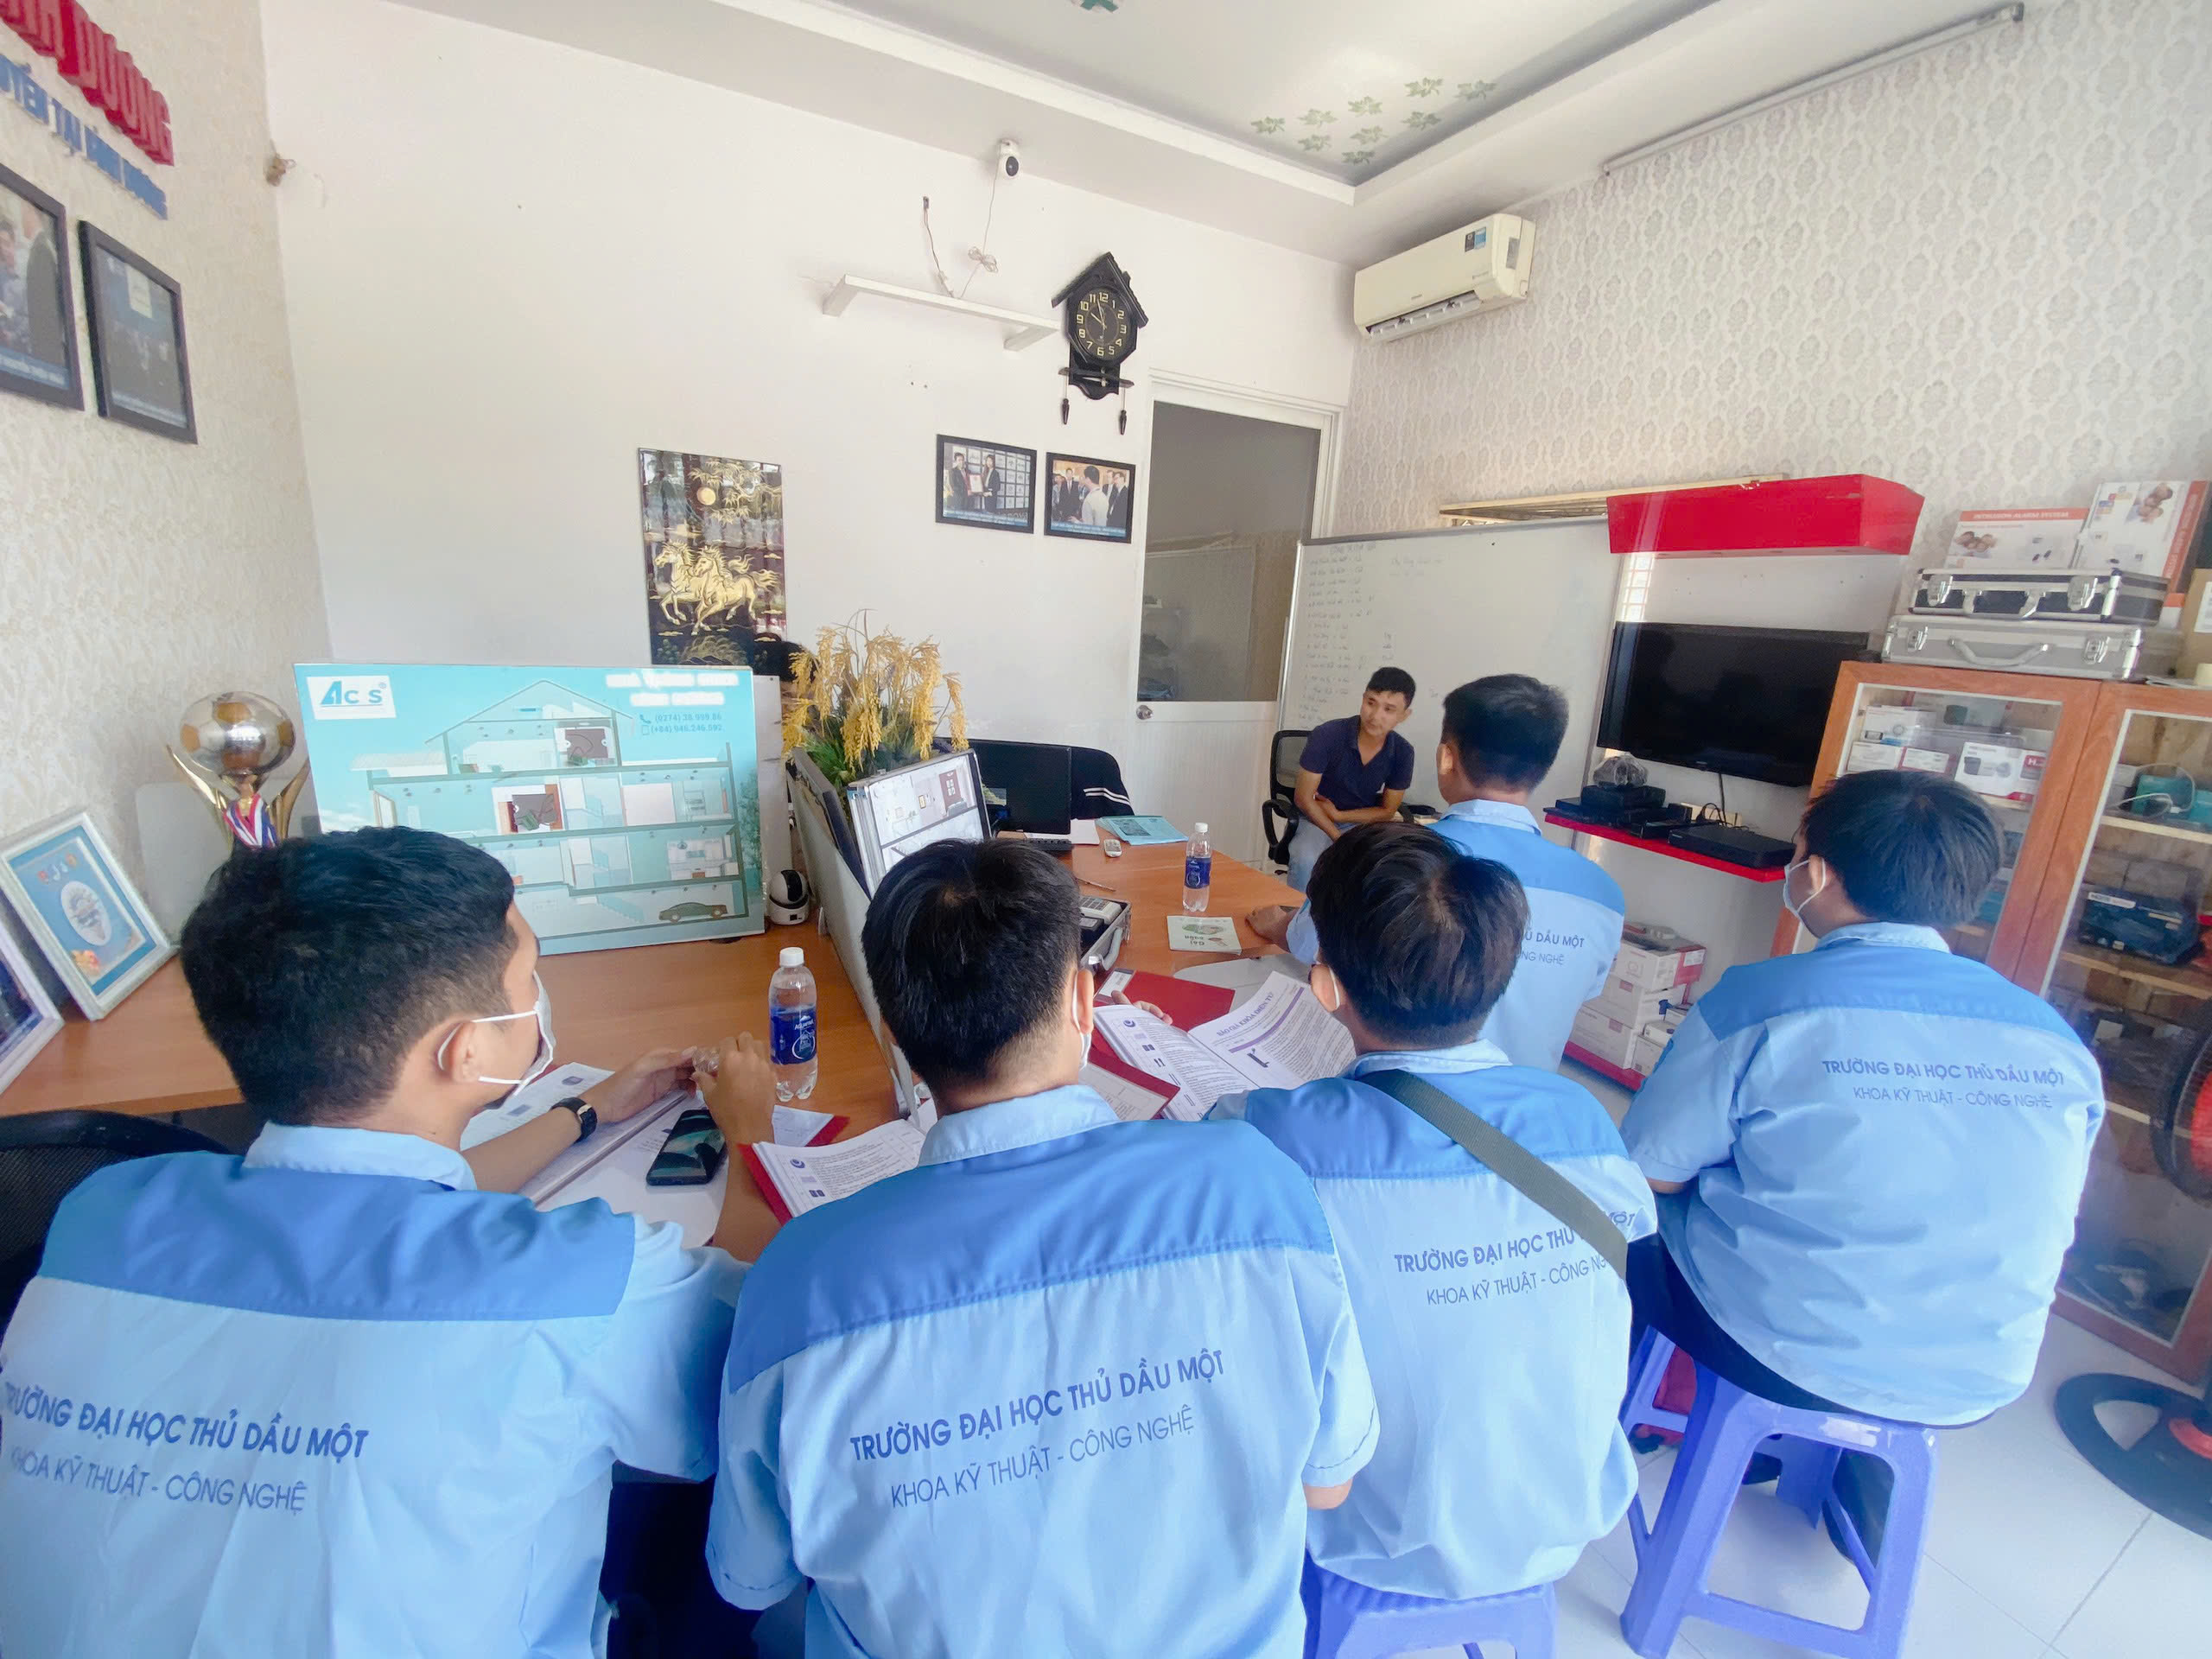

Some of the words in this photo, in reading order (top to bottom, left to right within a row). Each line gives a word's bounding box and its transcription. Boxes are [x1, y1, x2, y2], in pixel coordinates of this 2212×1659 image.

[1090, 294, 1096, 303] 11
[1099, 292, 1109, 303] 12
[1080, 301, 1089, 311] 10
[1112, 300, 1116, 308] 1
[1076, 314, 1084, 324] 9
[1117, 310, 1124, 320] 2
[1078, 328, 1085, 338] 8
[1120, 324, 1127, 334] 3
[1086, 340, 1093, 350] 7
[1115, 338, 1122, 346] 4
[1096, 346, 1104, 356] 6
[1108, 346, 1115, 355] 5
[1822, 1058, 1890, 1075] TRƯỜNG
[1894, 1063, 1922, 1078] ĐẠI
[1924, 1065, 1961, 1081] HỌC
[1853, 1087, 1891, 1100] KHOA
[1894, 1087, 1910, 1102] KỸ
[1966, 1090, 2011, 1106] CÔNG
[1395, 1248, 1469, 1273] TRƯỜNG
[1474, 1243, 1503, 1265] ĐẠI
[1508, 1234, 1544, 1259] HỌC
[1427, 1287, 1469, 1306] KHOA
[1471, 1279, 1491, 1300] KỸ
[1494, 1272, 1537, 1295] THUẬT
[1549, 1260, 1589, 1285] CÔNG
[850, 1418, 952, 1461] TRƯỜNG
[960, 1405, 1002, 1440] ĐẠI
[1009, 1389, 1064, 1430] HỌC
[1067, 1367, 1112, 1411] THỦ
[1118, 1357, 1172, 1398] DẦU
[1178, 1347, 1224, 1383] MỘT
[79, 1402, 124, 1440] ĐẠI
[126, 1409, 187, 1446] HỌC
[189, 1408, 238, 1448] THỦ
[306, 1422, 370, 1464] MỘT
[891, 1476, 950, 1509] KHOA
[955, 1462, 982, 1496] KỸ
[987, 1444, 1051, 1486] THUẬT
[1070, 1424, 1133, 1463] CÔNG
[1137, 1404, 1195, 1444] NGHỆ
[86, 1462, 149, 1499] THUẬT
[165, 1471, 235, 1506] CÔNG
[238, 1480, 307, 1516] NGHỆ
